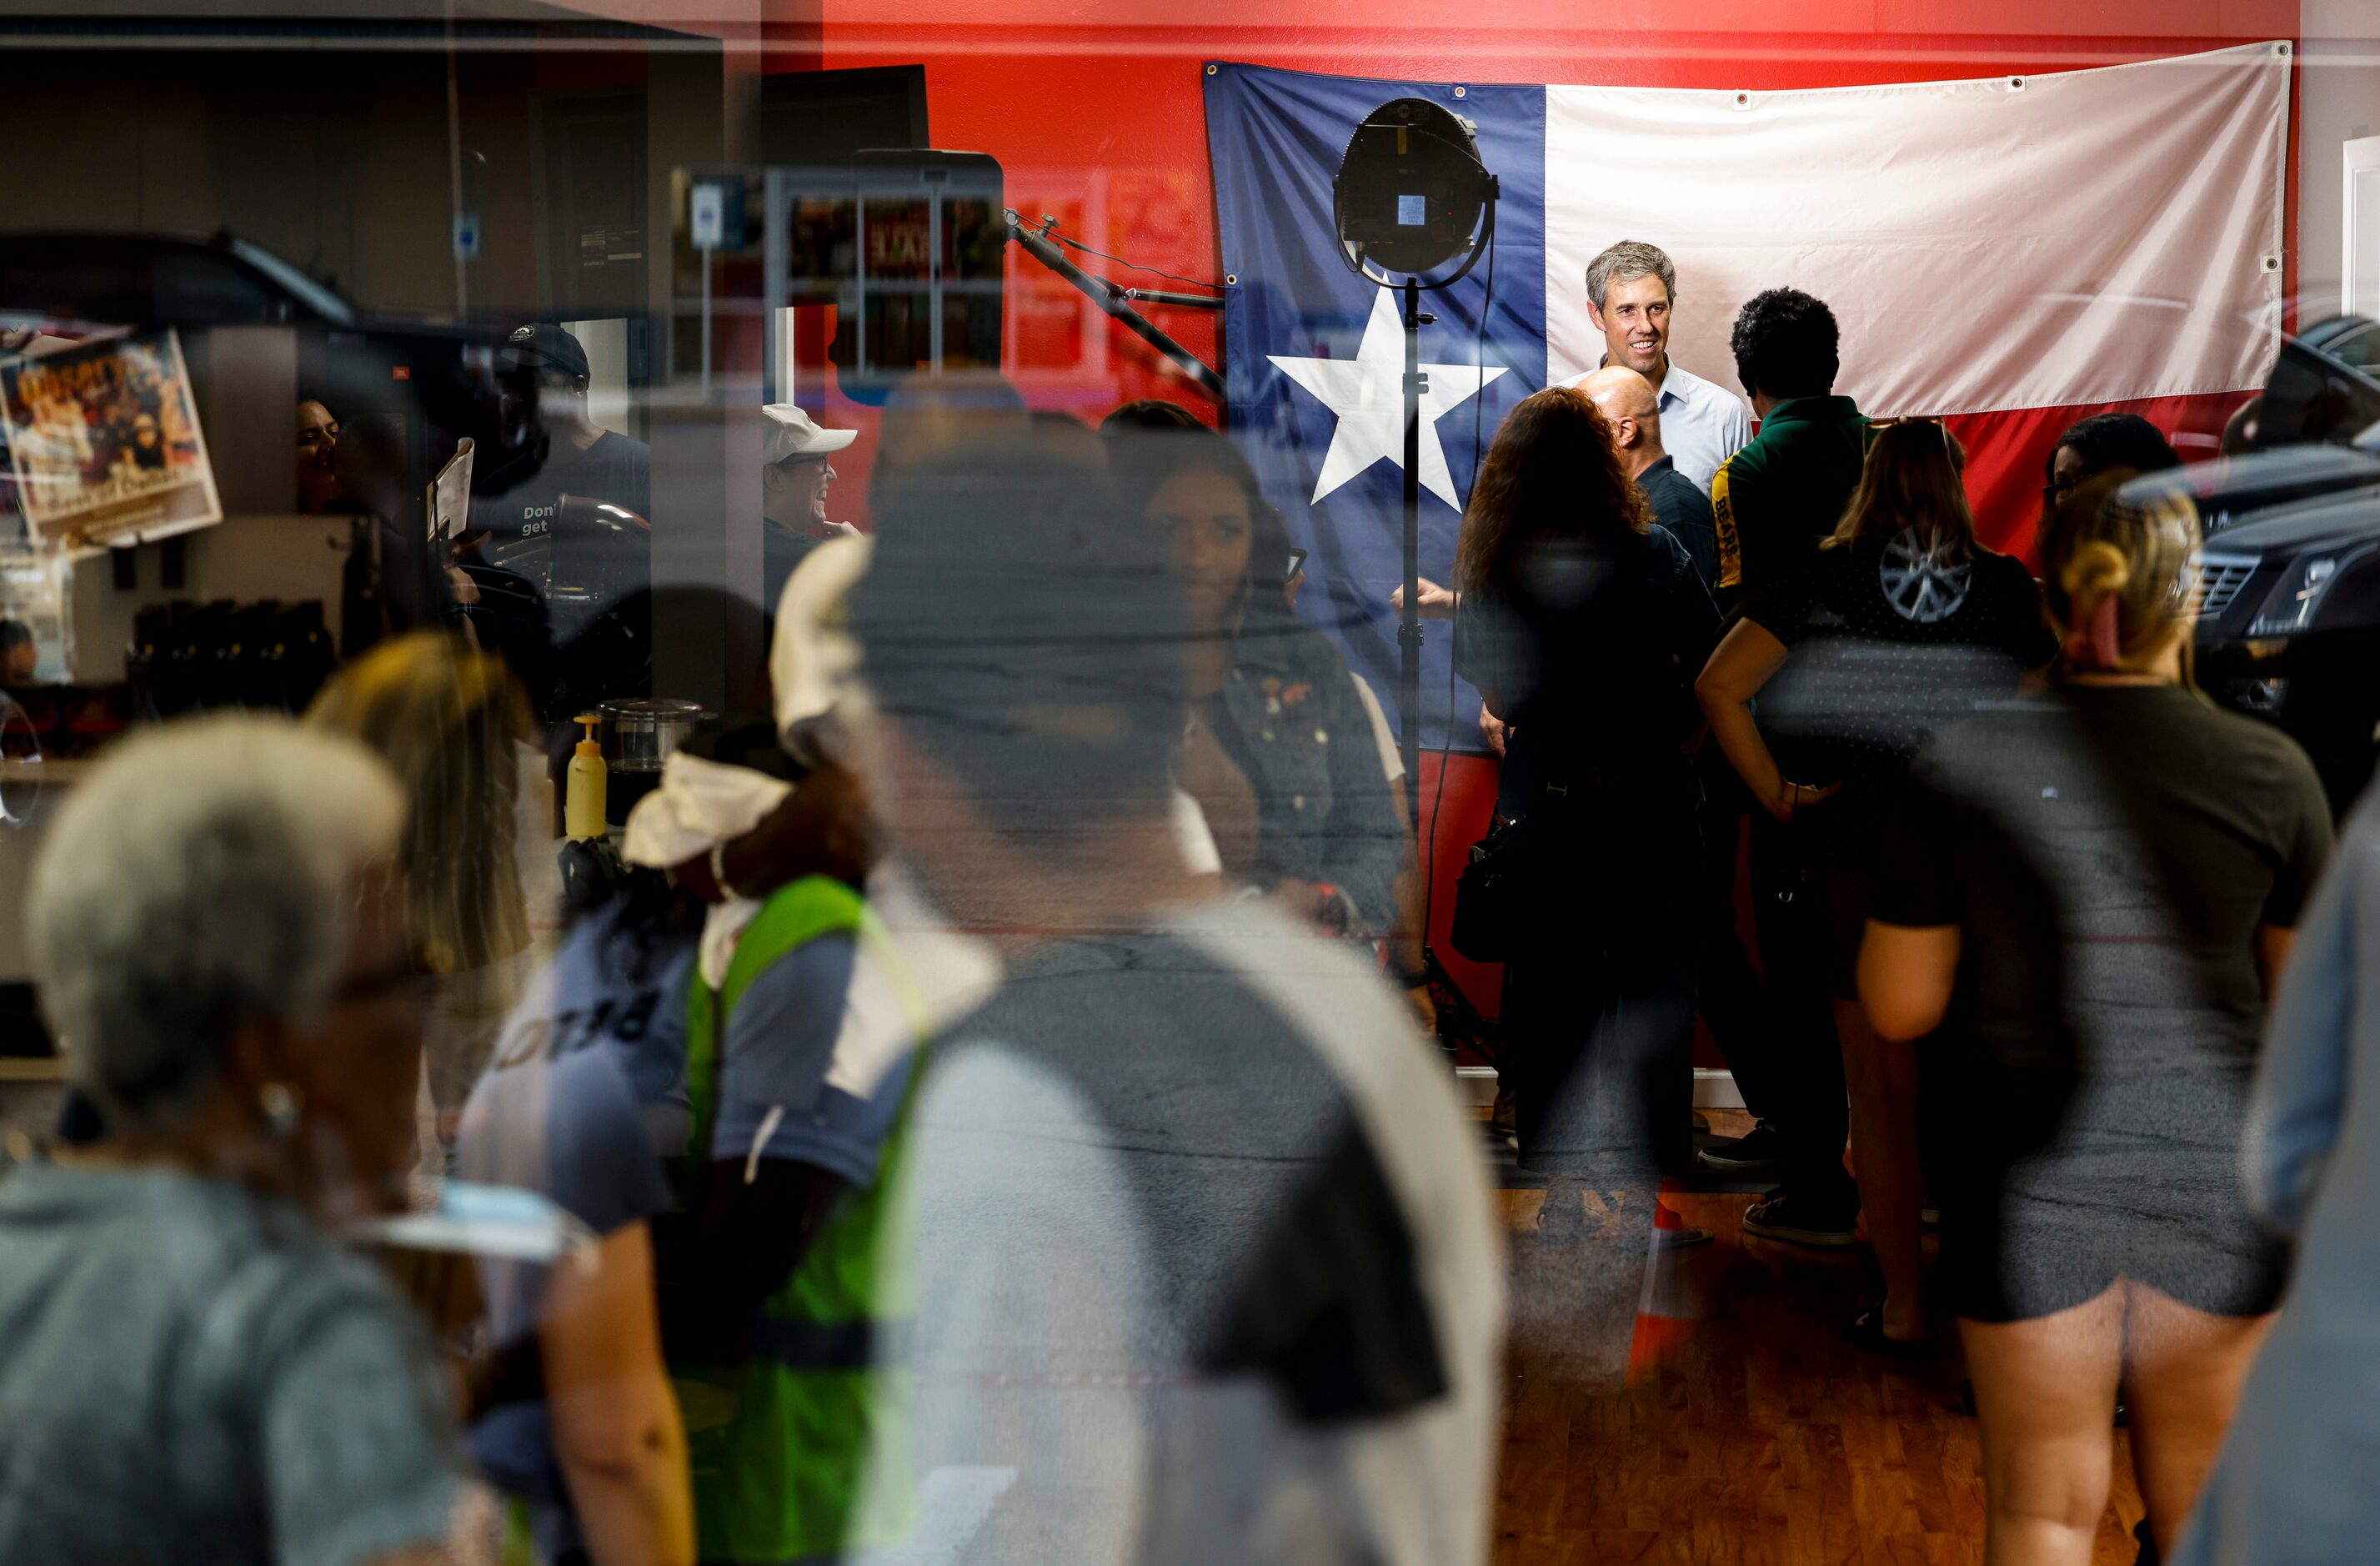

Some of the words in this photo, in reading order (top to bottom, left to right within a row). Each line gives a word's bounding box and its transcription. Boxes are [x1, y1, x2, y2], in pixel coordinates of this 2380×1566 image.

[524, 503, 557, 519] Don'
[522, 519, 548, 536] get
[1715, 494, 1737, 558] BEARS
